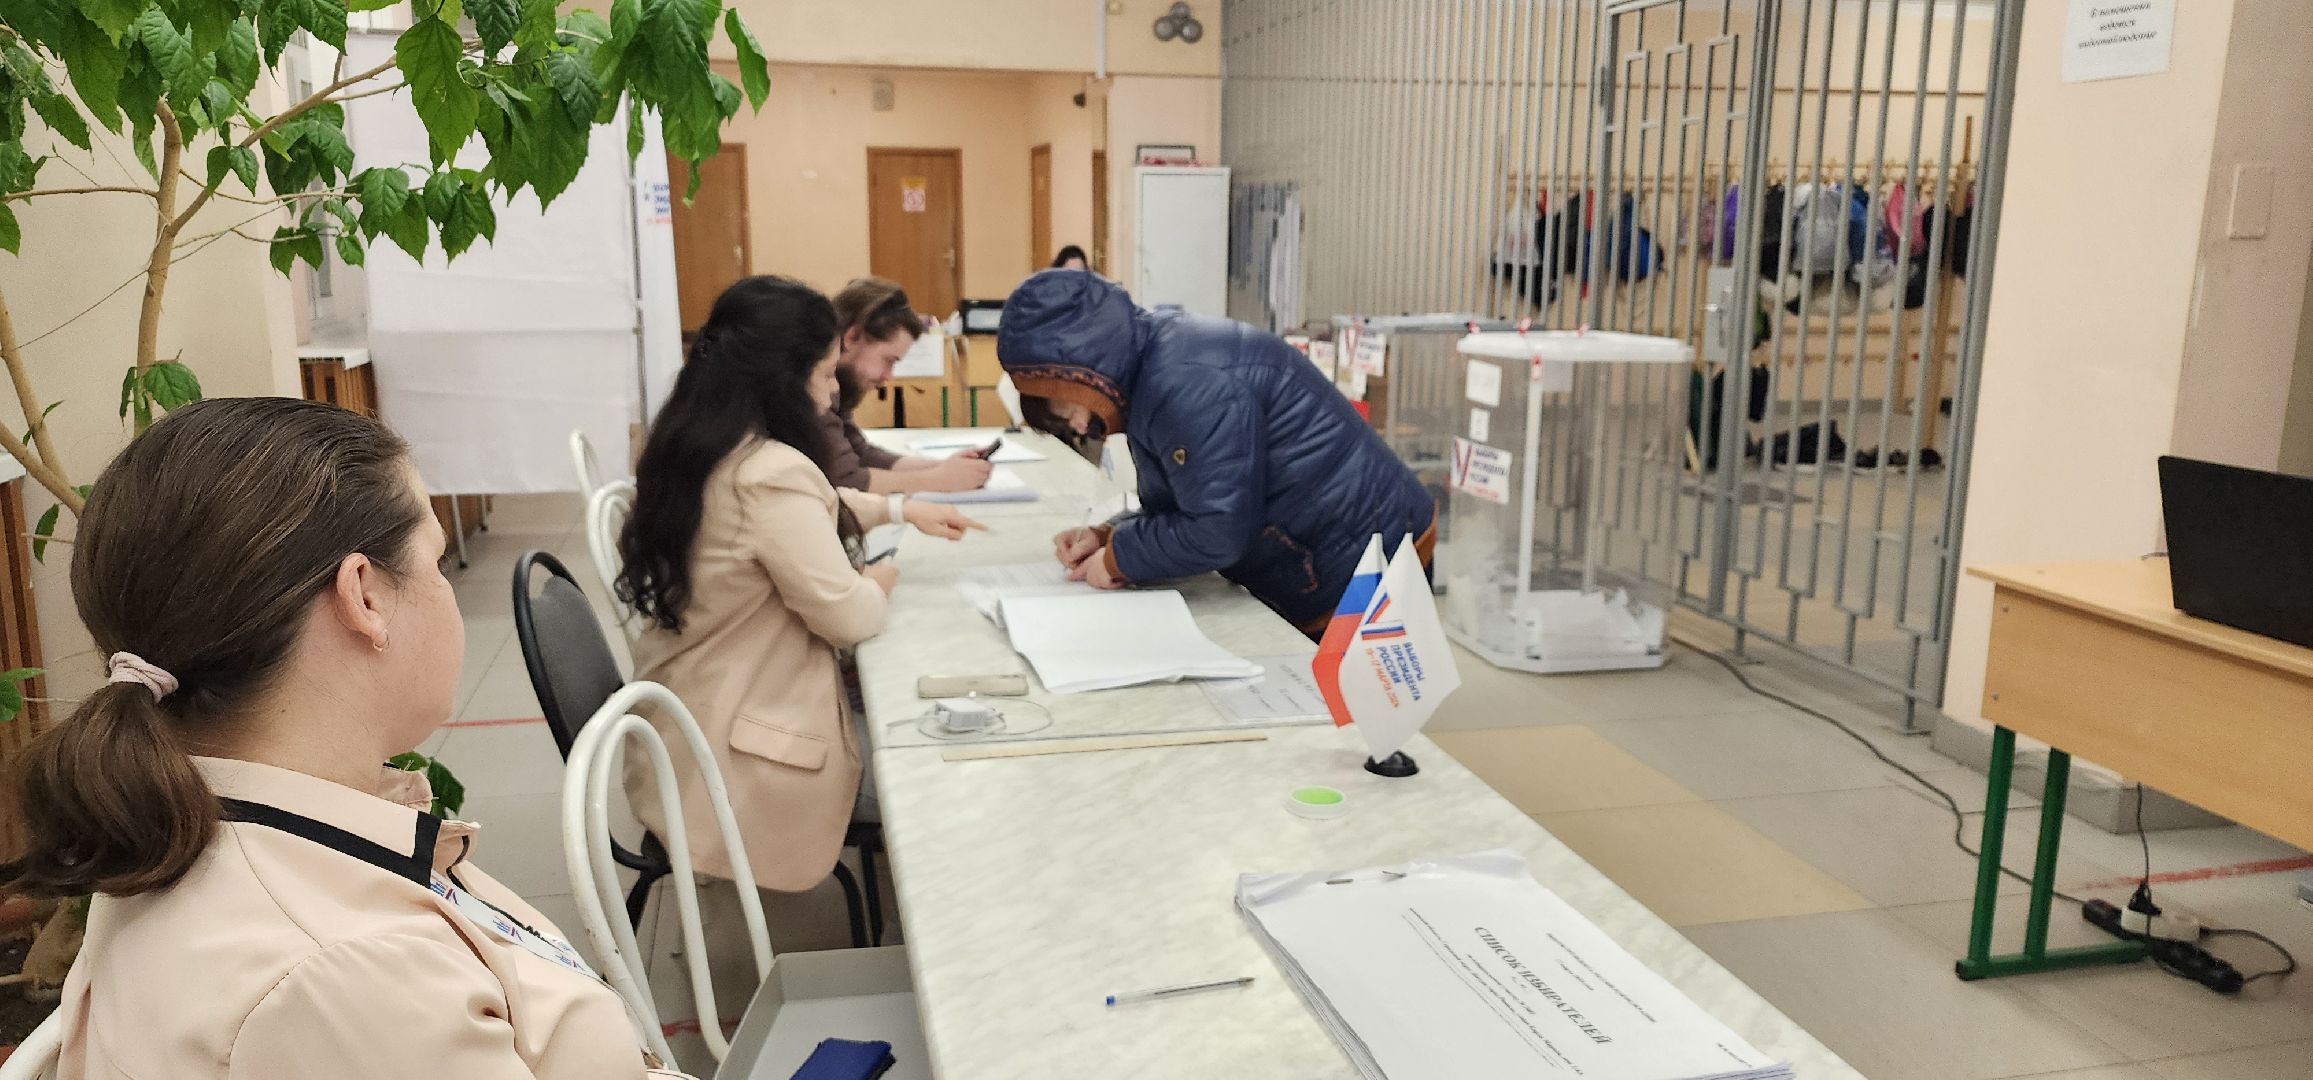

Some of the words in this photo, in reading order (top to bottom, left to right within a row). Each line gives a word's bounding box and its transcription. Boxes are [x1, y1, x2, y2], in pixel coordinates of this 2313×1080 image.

[1376, 645, 1402, 684] РОССИИ
[1390, 643, 1422, 702] ПРЕЗИДЕНТА
[1403, 641, 1426, 682] ВЫБОРЫ
[1474, 926, 1524, 969] СПИСОК
[1518, 967, 1614, 1046] ИЗБИРАТЕЛЕЙ
